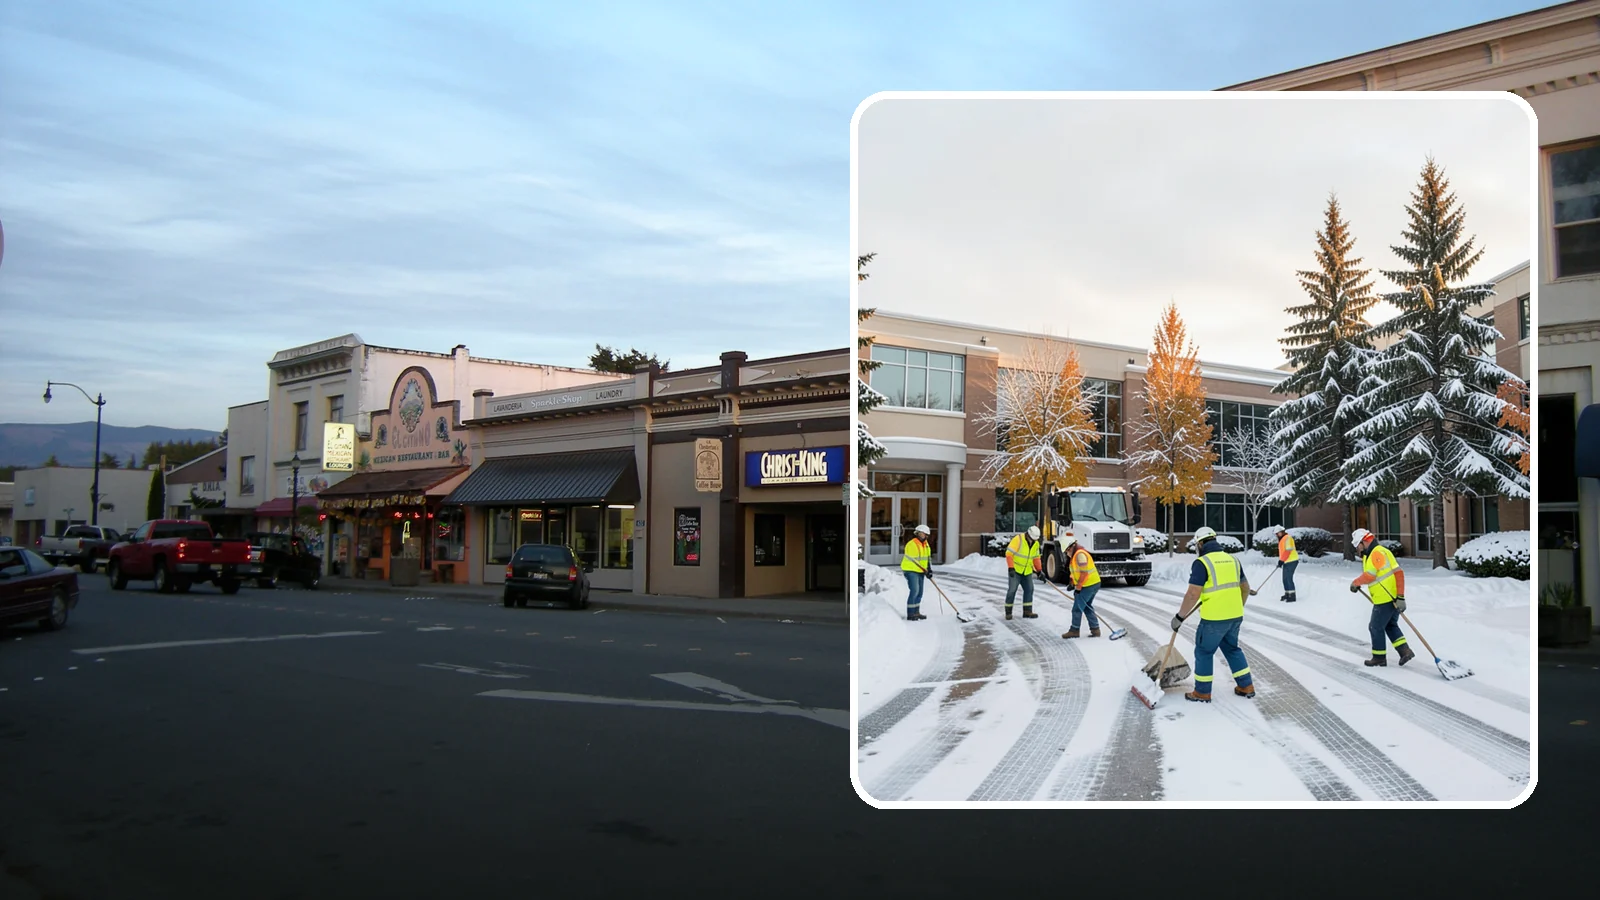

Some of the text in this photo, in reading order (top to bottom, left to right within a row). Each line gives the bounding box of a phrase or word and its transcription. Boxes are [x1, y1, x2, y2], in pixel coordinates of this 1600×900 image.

[562, 394, 582, 404] Shop
[596, 389, 624, 400] LAUNDRY
[494, 402, 522, 412] LAVANDERIA
[374, 455, 396, 464] MEXICAN
[398, 451, 434, 462] RESTAURANT
[438, 450, 450, 459] BAR
[761, 450, 827, 478] CHRIST KING
[697, 480, 722, 489] Coffee House
